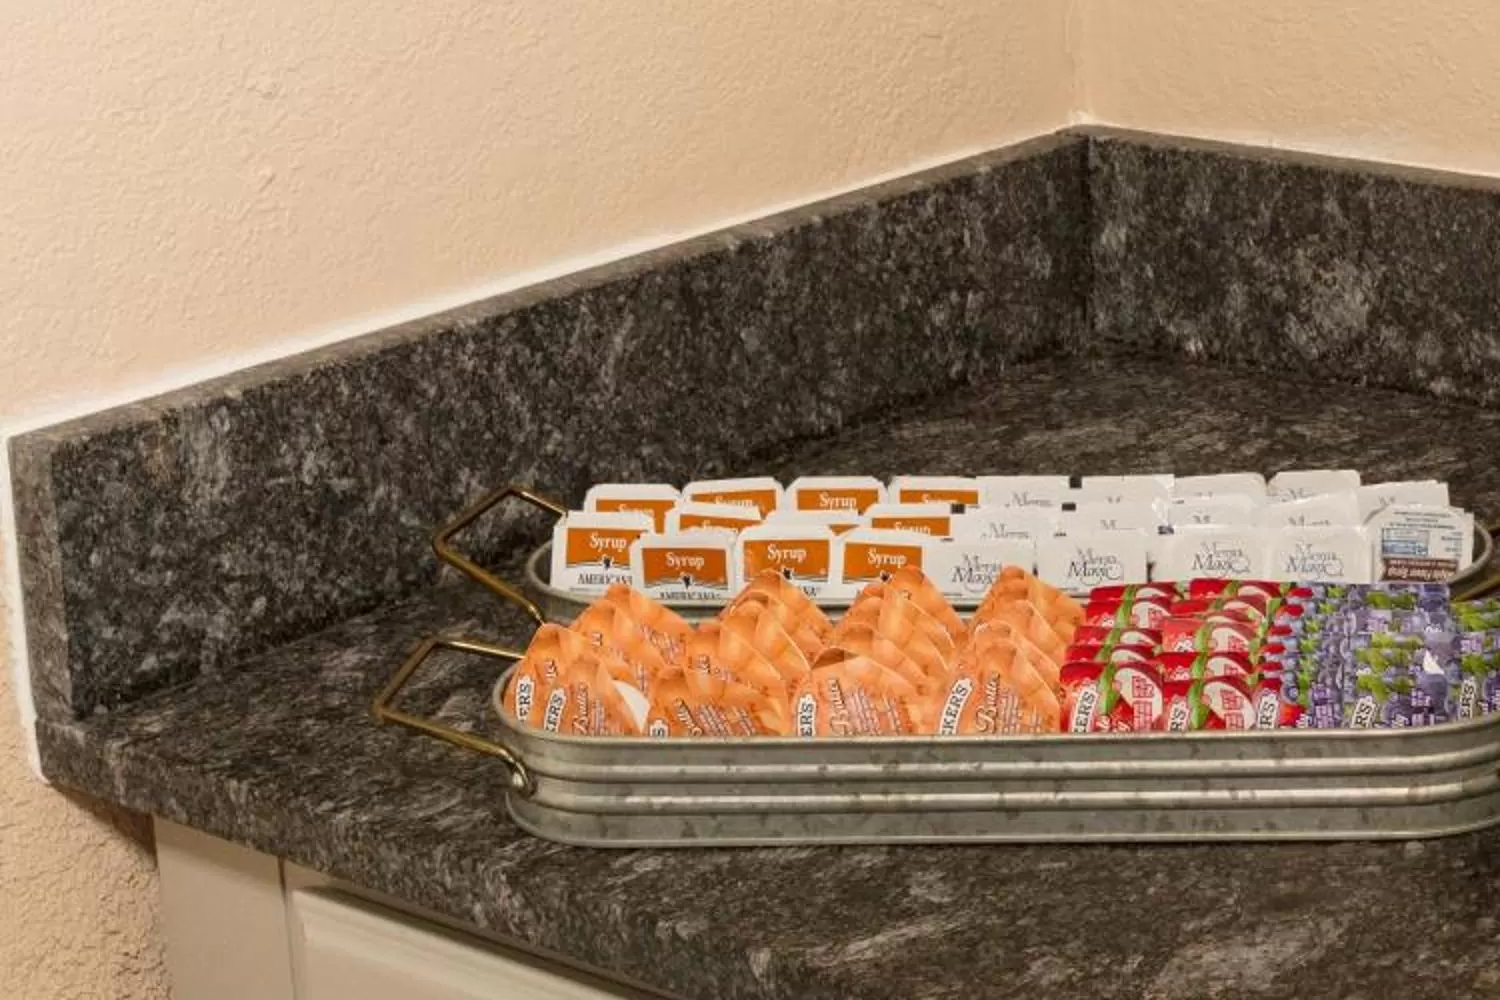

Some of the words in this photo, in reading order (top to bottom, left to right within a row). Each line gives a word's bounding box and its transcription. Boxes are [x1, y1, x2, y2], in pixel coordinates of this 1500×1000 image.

[819, 492, 857, 510] Syrup
[590, 532, 627, 552] Syrup
[666, 552, 705, 570] Syrup
[767, 544, 807, 563] Syrup
[868, 549, 907, 568] Syrup
